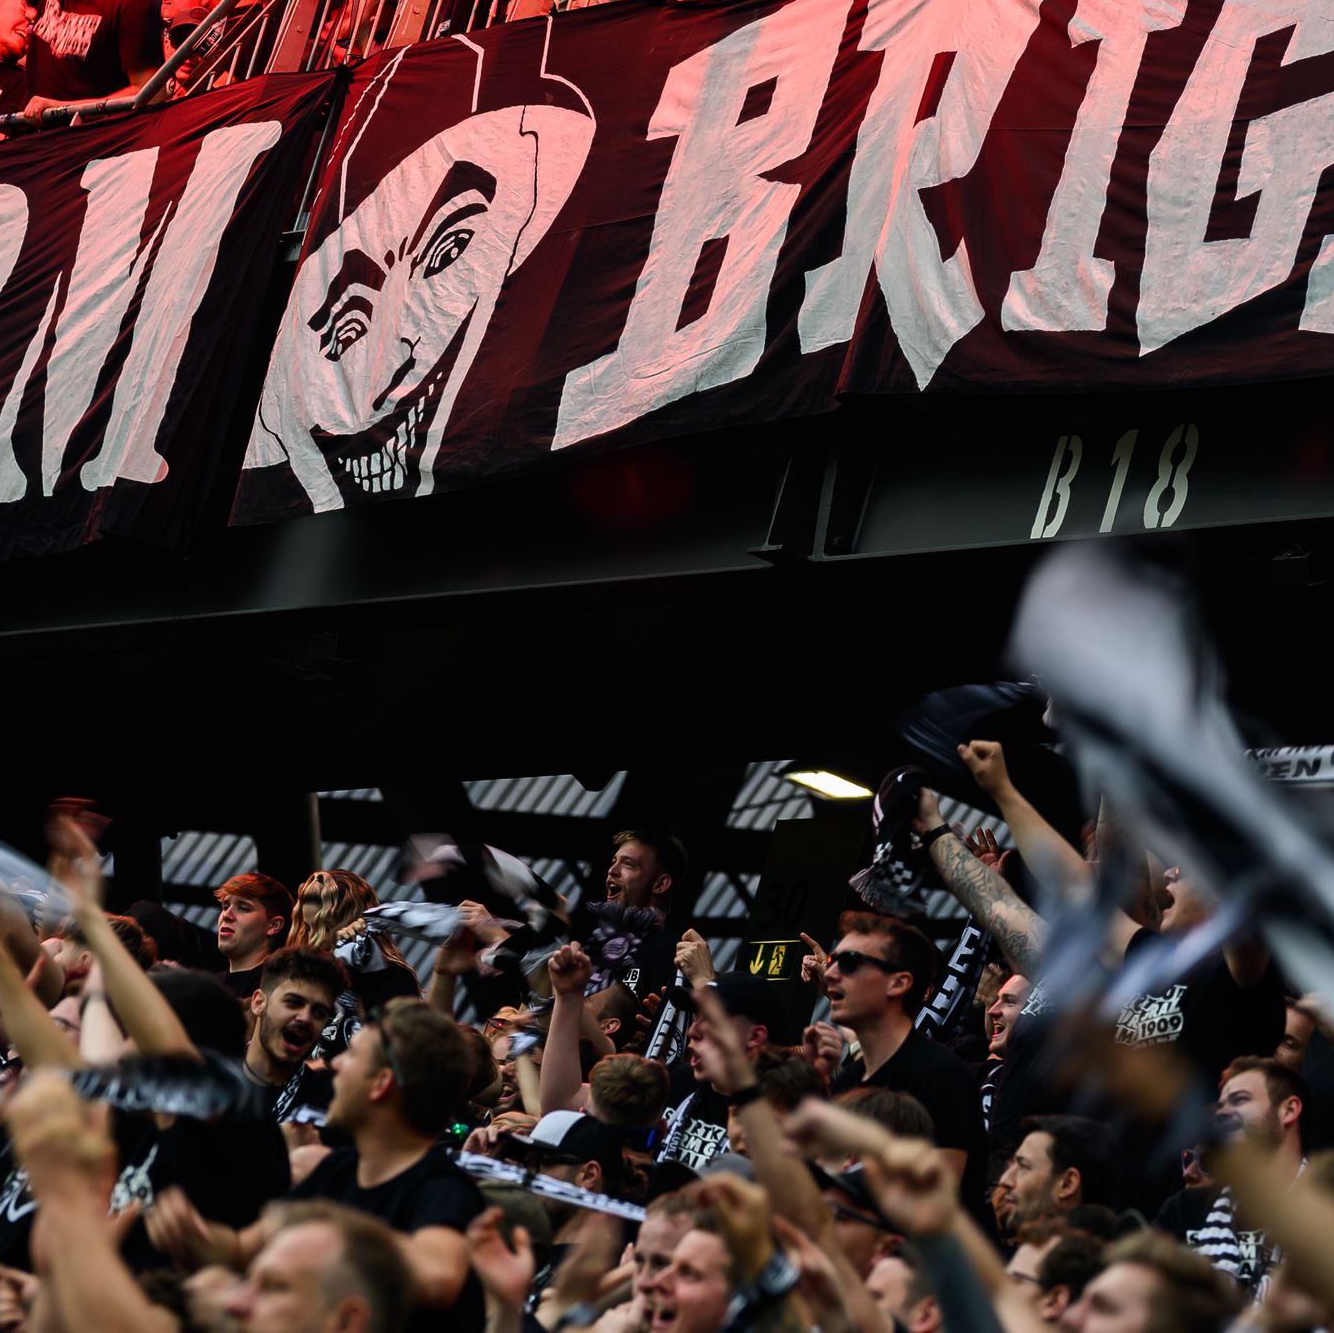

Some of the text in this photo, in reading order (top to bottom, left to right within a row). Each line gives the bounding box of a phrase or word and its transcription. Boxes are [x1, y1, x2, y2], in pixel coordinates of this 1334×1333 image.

[1030, 422, 1200, 540] B18
[1259, 757, 1323, 780] EN
[1140, 1016, 1182, 1038] 1909
